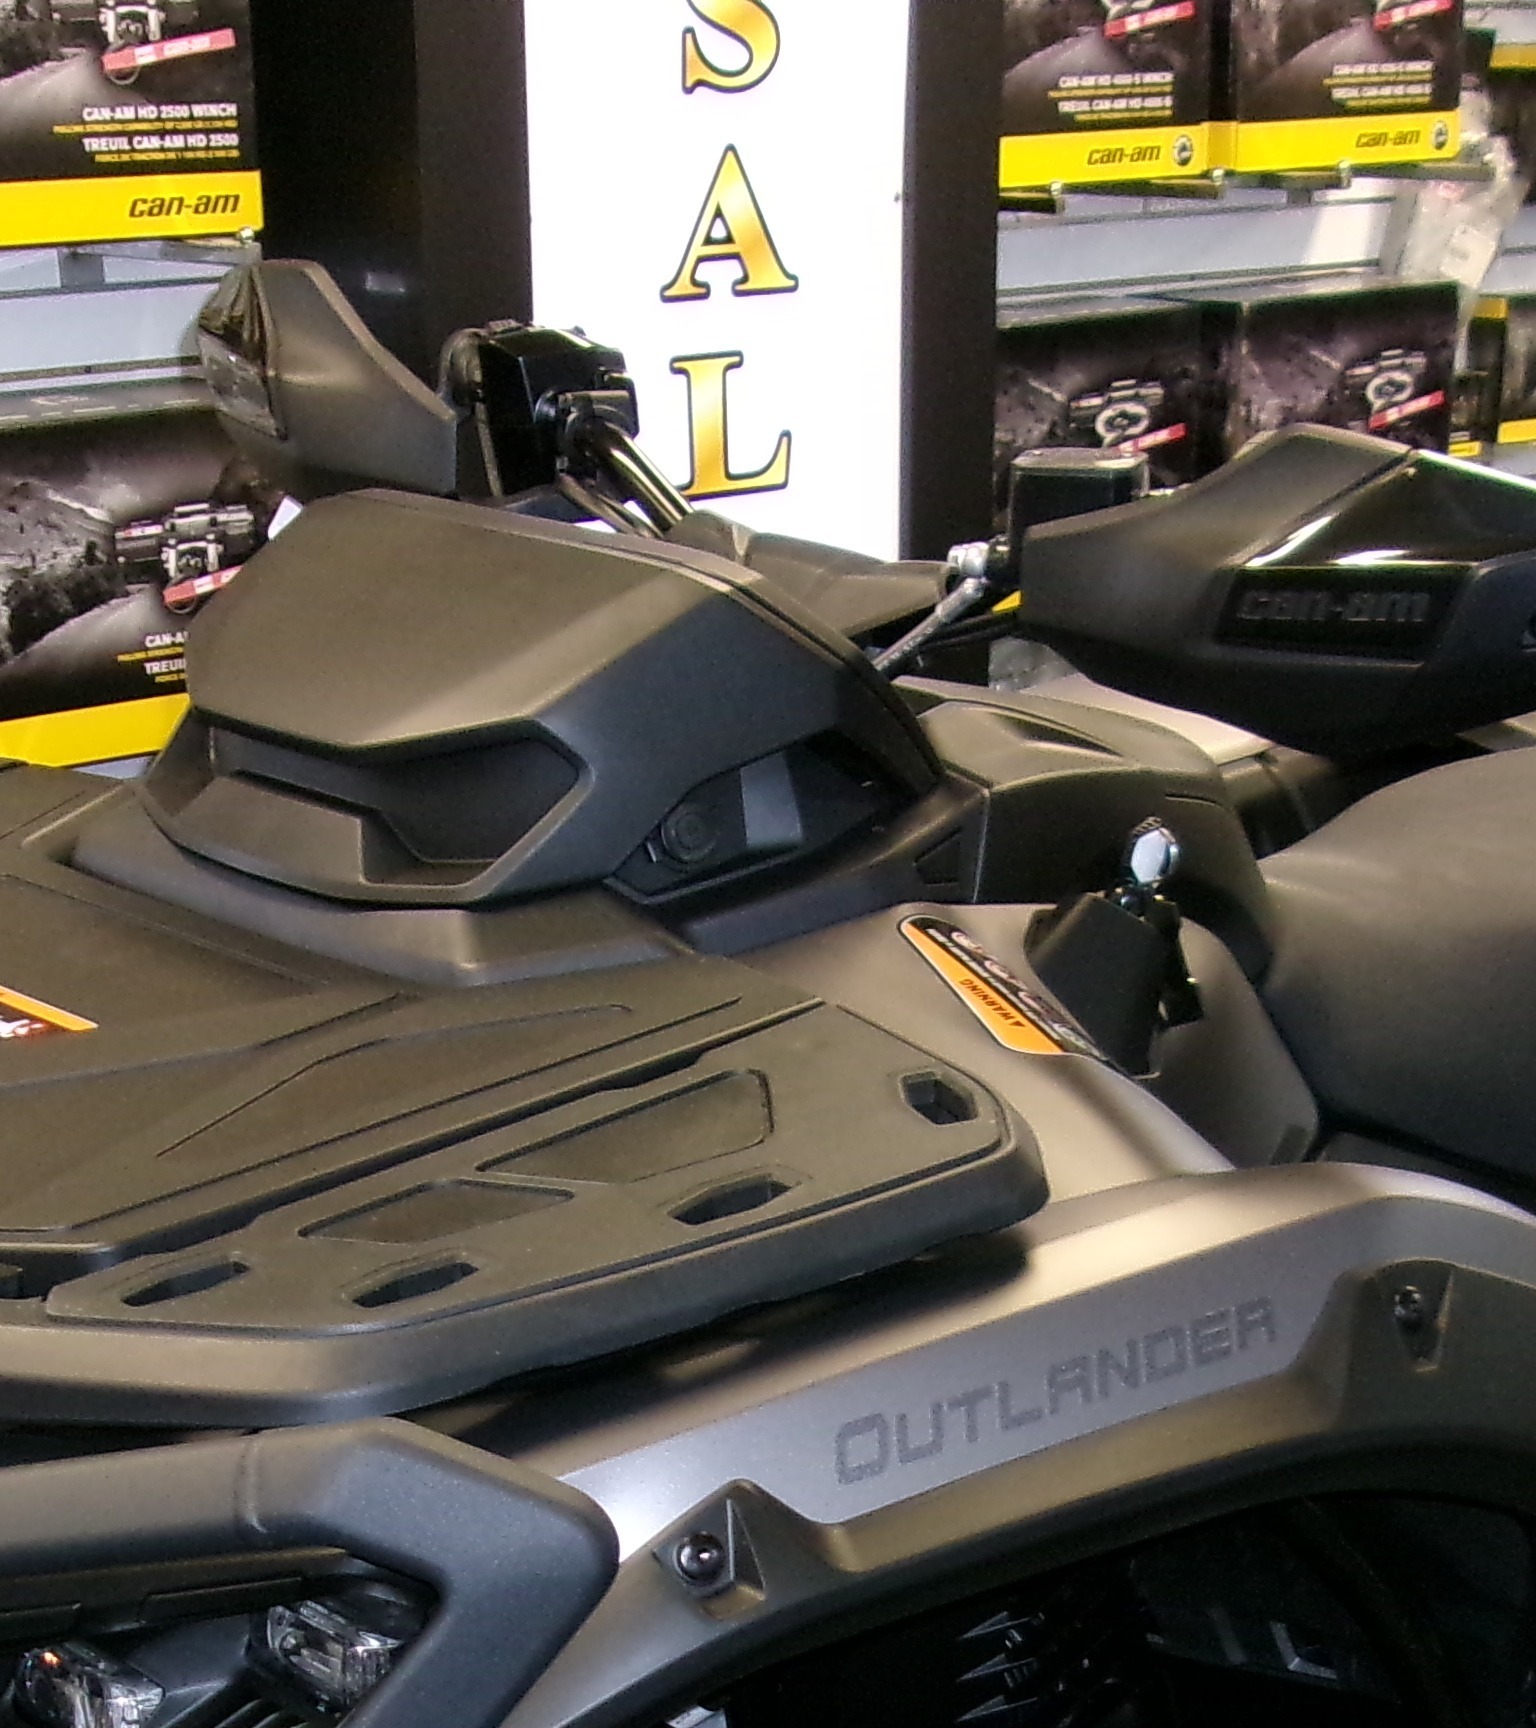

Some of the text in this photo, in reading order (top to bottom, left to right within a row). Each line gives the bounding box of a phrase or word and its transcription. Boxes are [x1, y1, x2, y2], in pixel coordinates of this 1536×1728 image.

[82, 102, 238, 121] CAN-AM HD 2500 WINCH
[82, 132, 240, 151] TREUIL CAN-AM HD 2500
[1355, 129, 1421, 148] can-am
[1087, 144, 1162, 166] can-am
[128, 193, 241, 219] can-am
[1235, 590, 1432, 622] can-am
[144, 630, 188, 648] CAN-A
[958, 978, 1016, 1021] WARNING
[833, 1296, 1278, 1487] OUTLANDER
